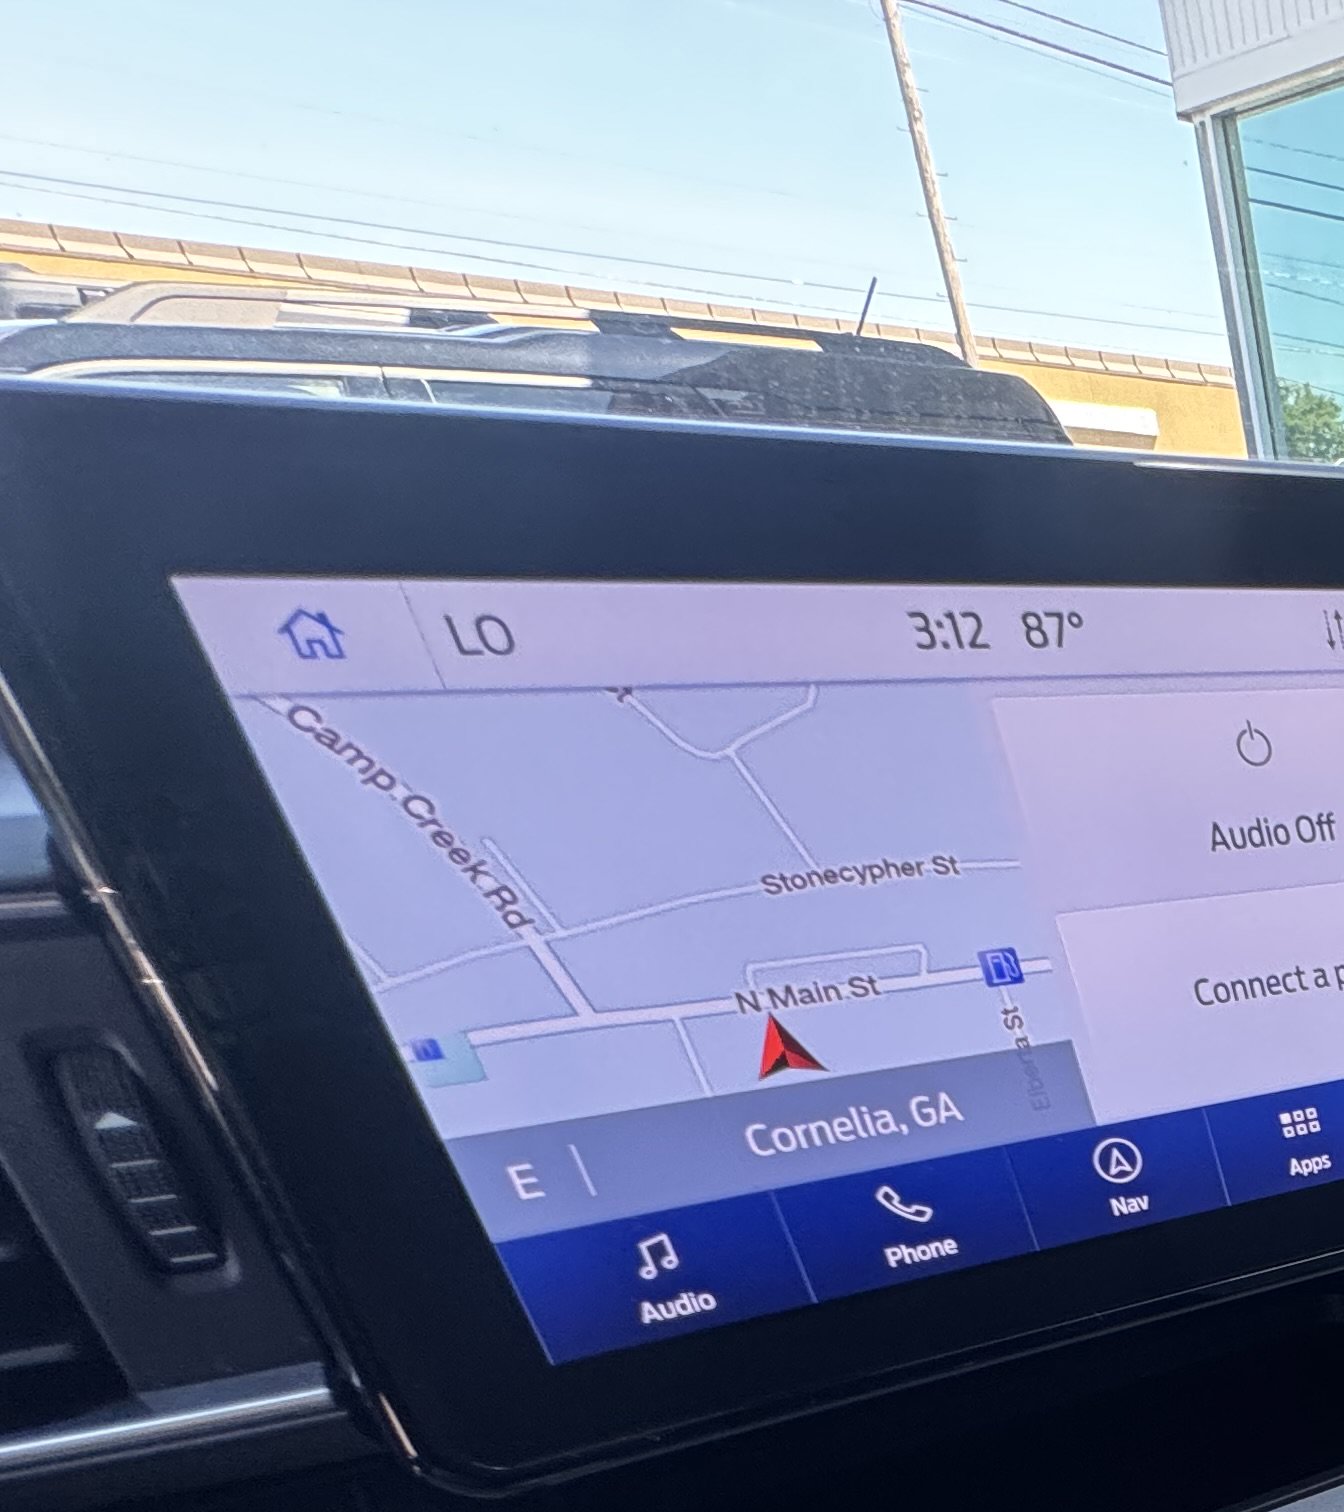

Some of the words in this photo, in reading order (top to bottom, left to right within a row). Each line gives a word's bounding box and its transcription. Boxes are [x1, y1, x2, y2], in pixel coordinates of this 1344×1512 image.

[444, 614, 515, 656] LO
[907, 611, 991, 650] 3:12
[1020, 611, 1084, 649] 87°
[287, 705, 397, 791] Camp
[402, 794, 492, 885] Creek
[483, 884, 535, 929] Rd
[1210, 817, 1290, 853] Audio
[1295, 812, 1336, 844] Off
[761, 858, 926, 896] Stonecypher
[932, 855, 960, 875] St
[735, 990, 759, 1014] N
[768, 979, 841, 1011] Main
[848, 975, 879, 998] St
[1194, 965, 1309, 1006] Connect
[1313, 967, 1331, 988] a
[1001, 1006, 1024, 1030] St
[745, 1105, 908, 1157] Cornelia,
[909, 1092, 964, 1128] GA
[506, 1163, 545, 1201] E
[1289, 1153, 1332, 1177] Apps
[1110, 1194, 1149, 1218] Nav
[884, 1237, 959, 1269] Phone
[640, 1290, 717, 1325] Audio
